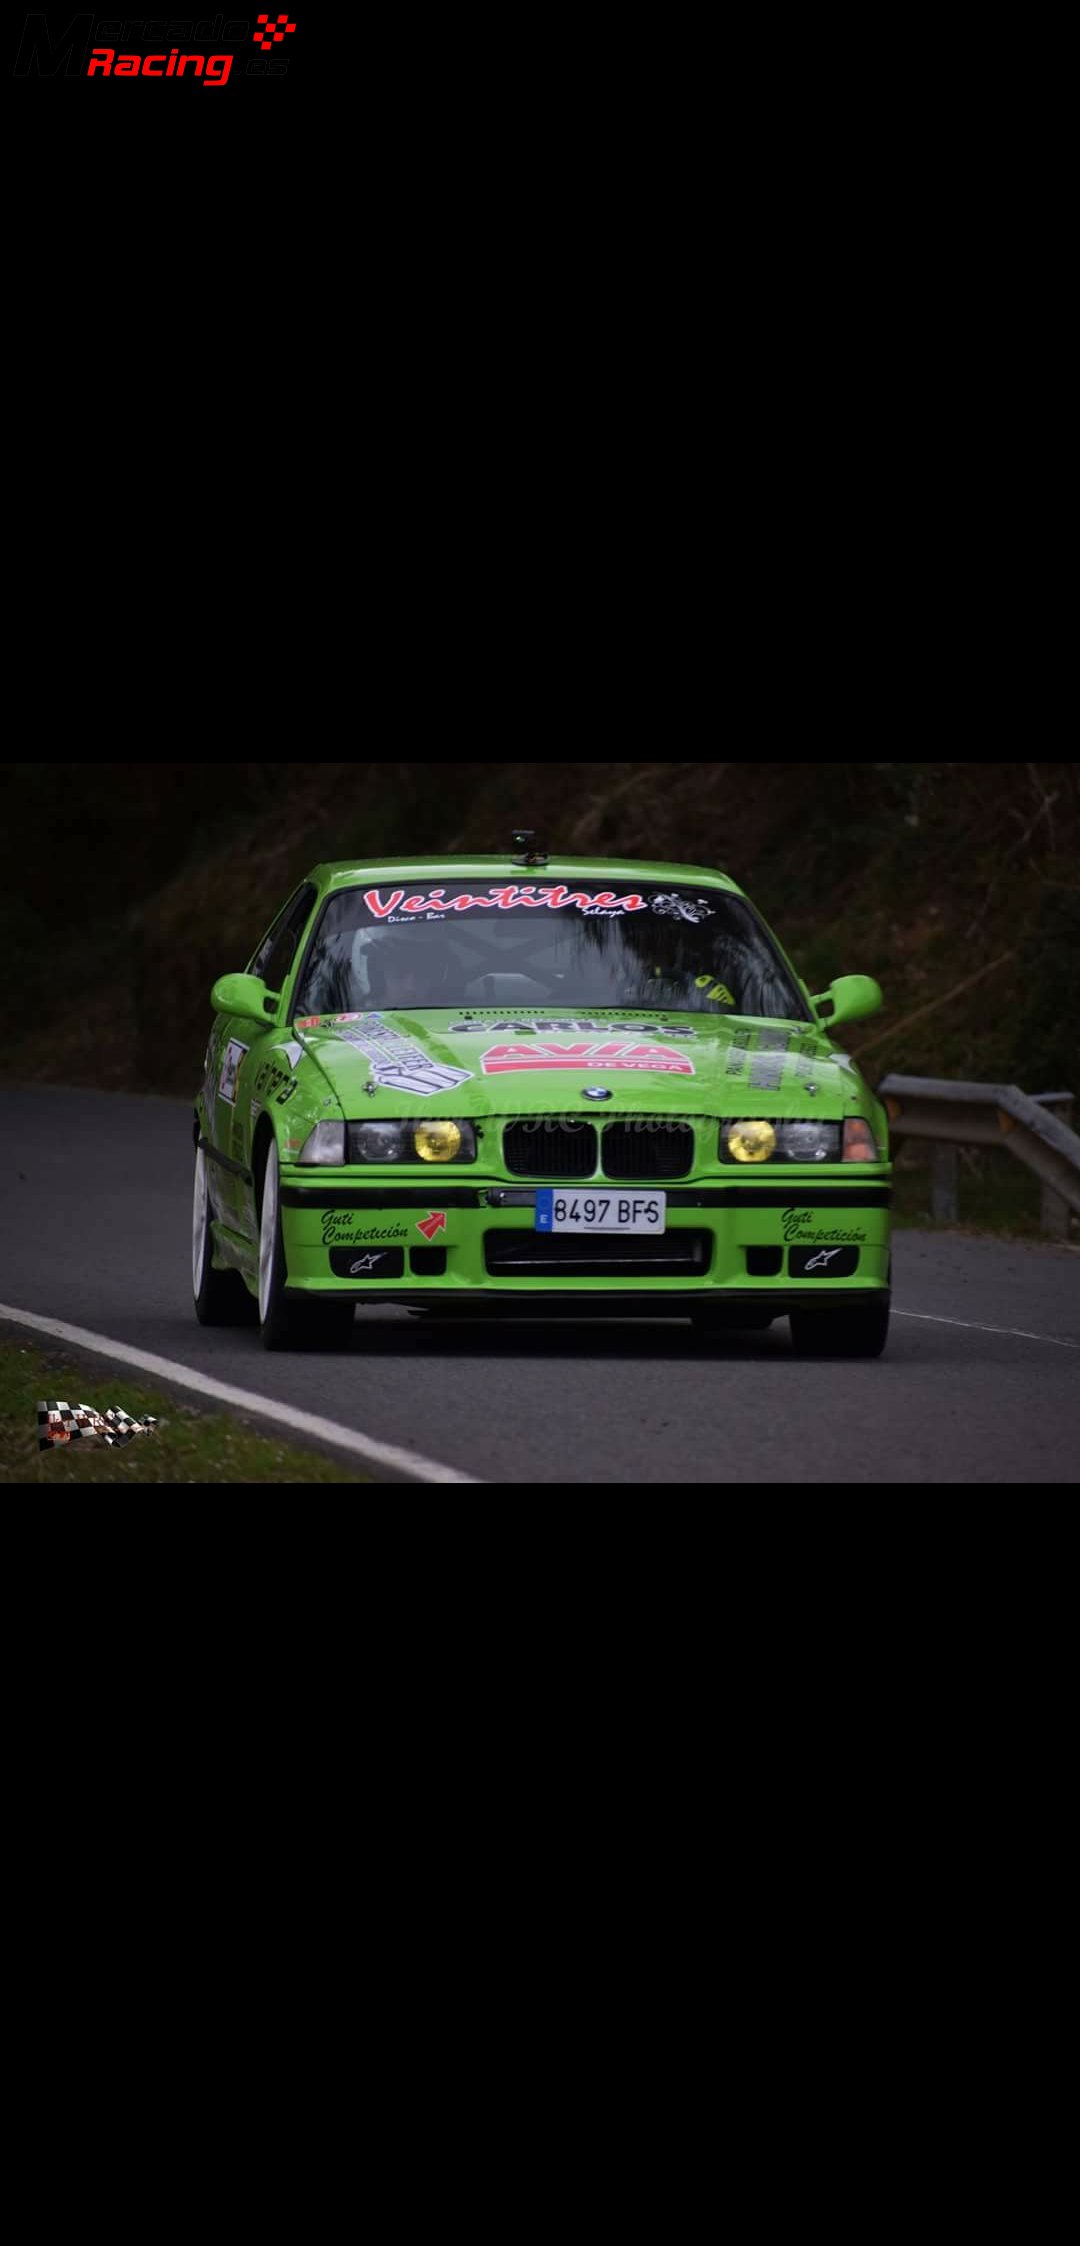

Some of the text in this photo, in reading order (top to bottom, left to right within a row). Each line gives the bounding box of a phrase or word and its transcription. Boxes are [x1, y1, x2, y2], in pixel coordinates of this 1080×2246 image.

[363, 885, 648, 918] Veintitres
[426, 912, 446, 922] Bar
[581, 906, 626, 918] Selaya
[450, 1019, 696, 1036] CARLOS
[480, 1042, 691, 1060] AVIA
[621, 1062, 684, 1071] VEGA
[321, 1210, 355, 1231] Guti
[540, 1199, 659, 1224] E 8497 BFS
[782, 1207, 814, 1228] Guti
[322, 1223, 408, 1245] Competición
[784, 1224, 867, 1243] Competición
